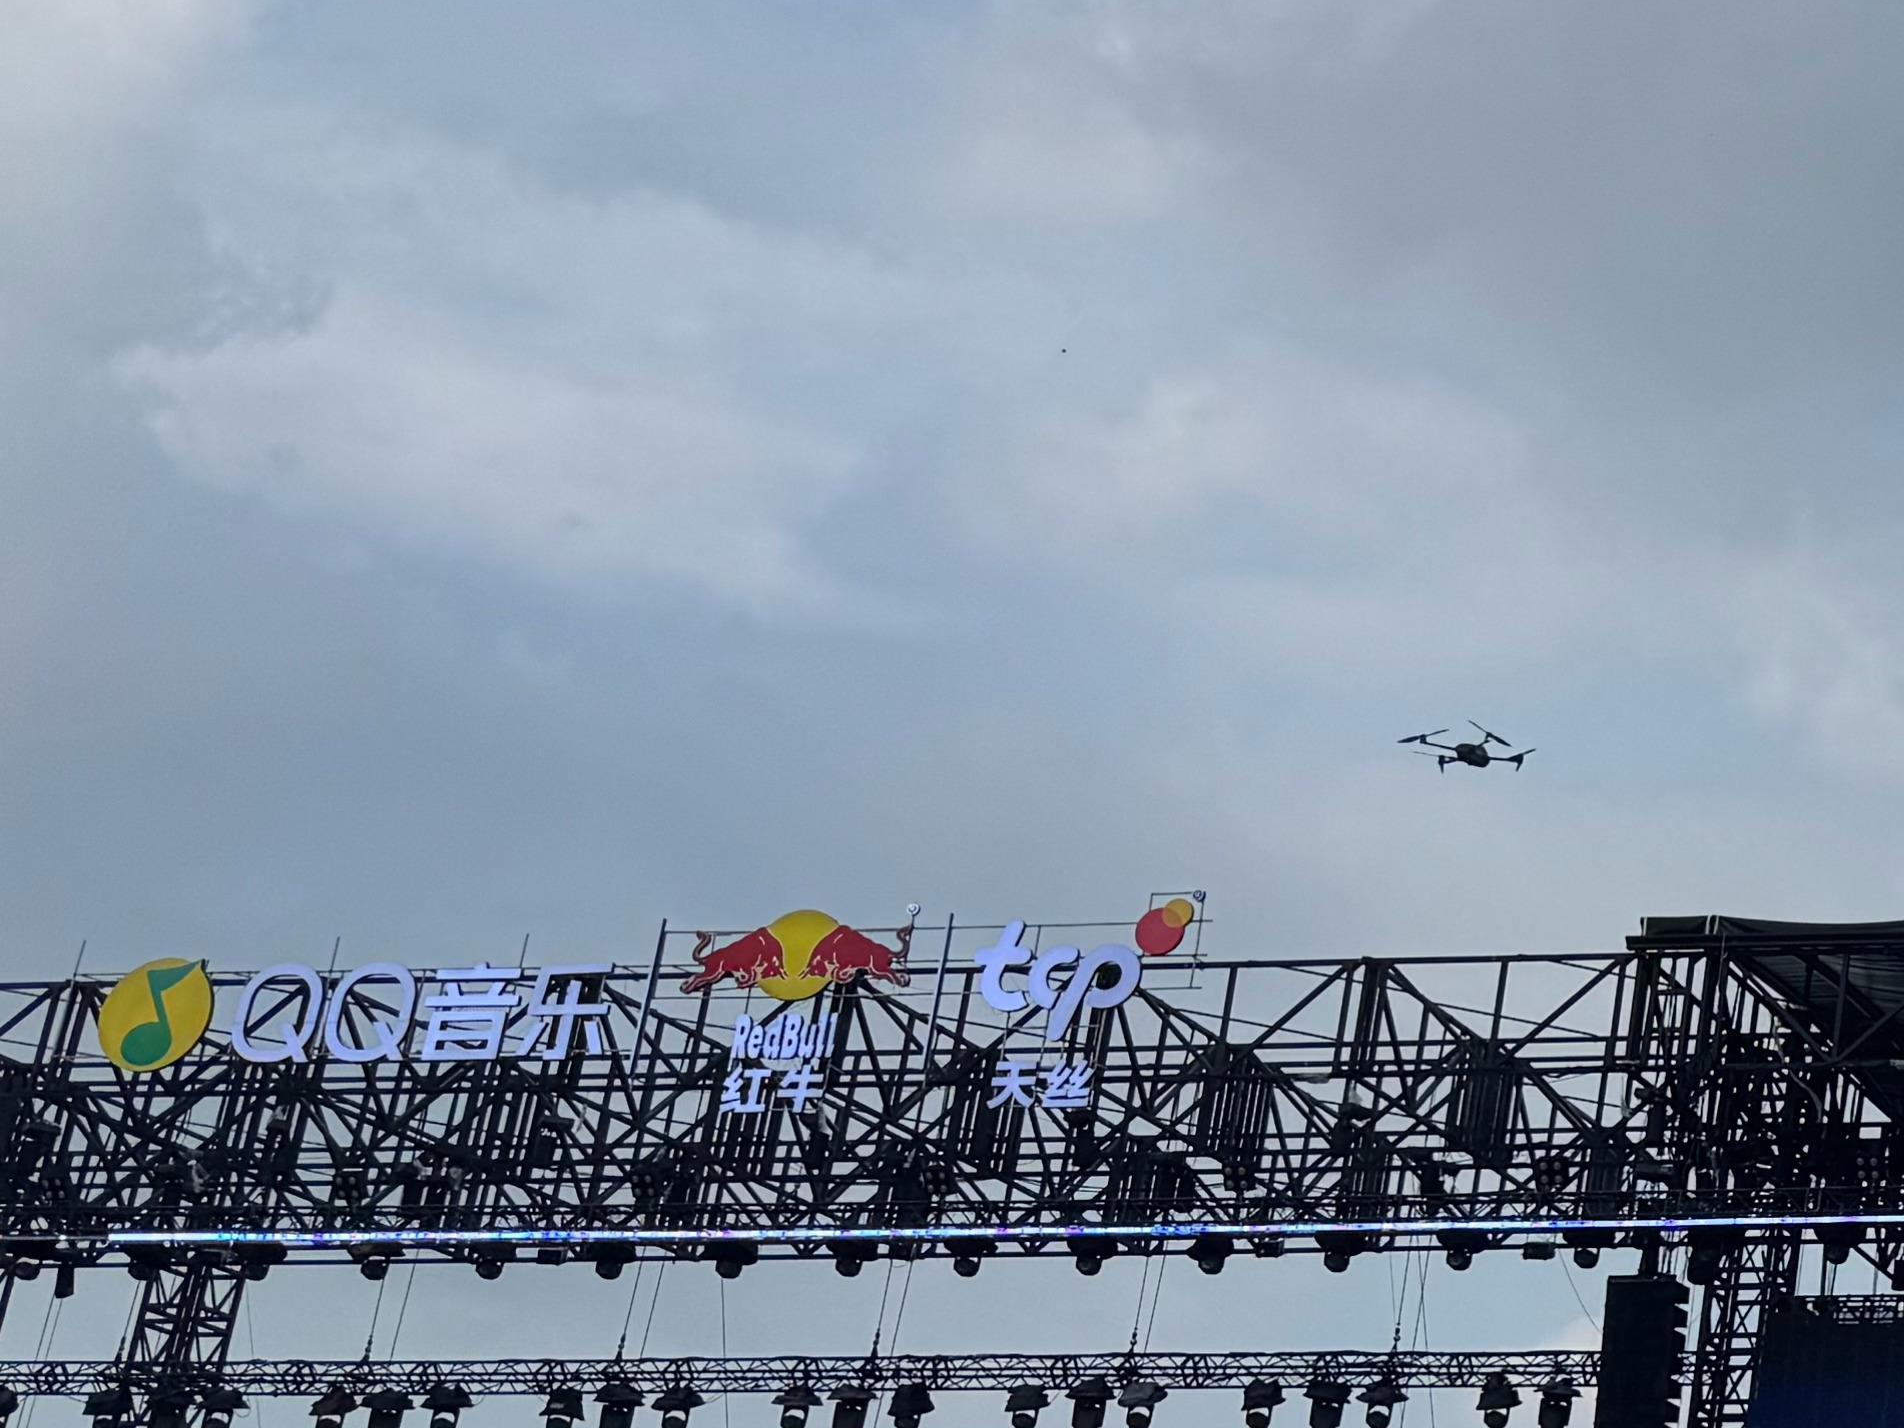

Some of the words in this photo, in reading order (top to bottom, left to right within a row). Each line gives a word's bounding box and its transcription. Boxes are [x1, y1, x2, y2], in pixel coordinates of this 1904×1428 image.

[231, 962, 614, 1063] QQ音乐
[974, 919, 1142, 1042] tcp
[720, 1063, 825, 1114] 红牛
[986, 1058, 1096, 1109] 天丝
